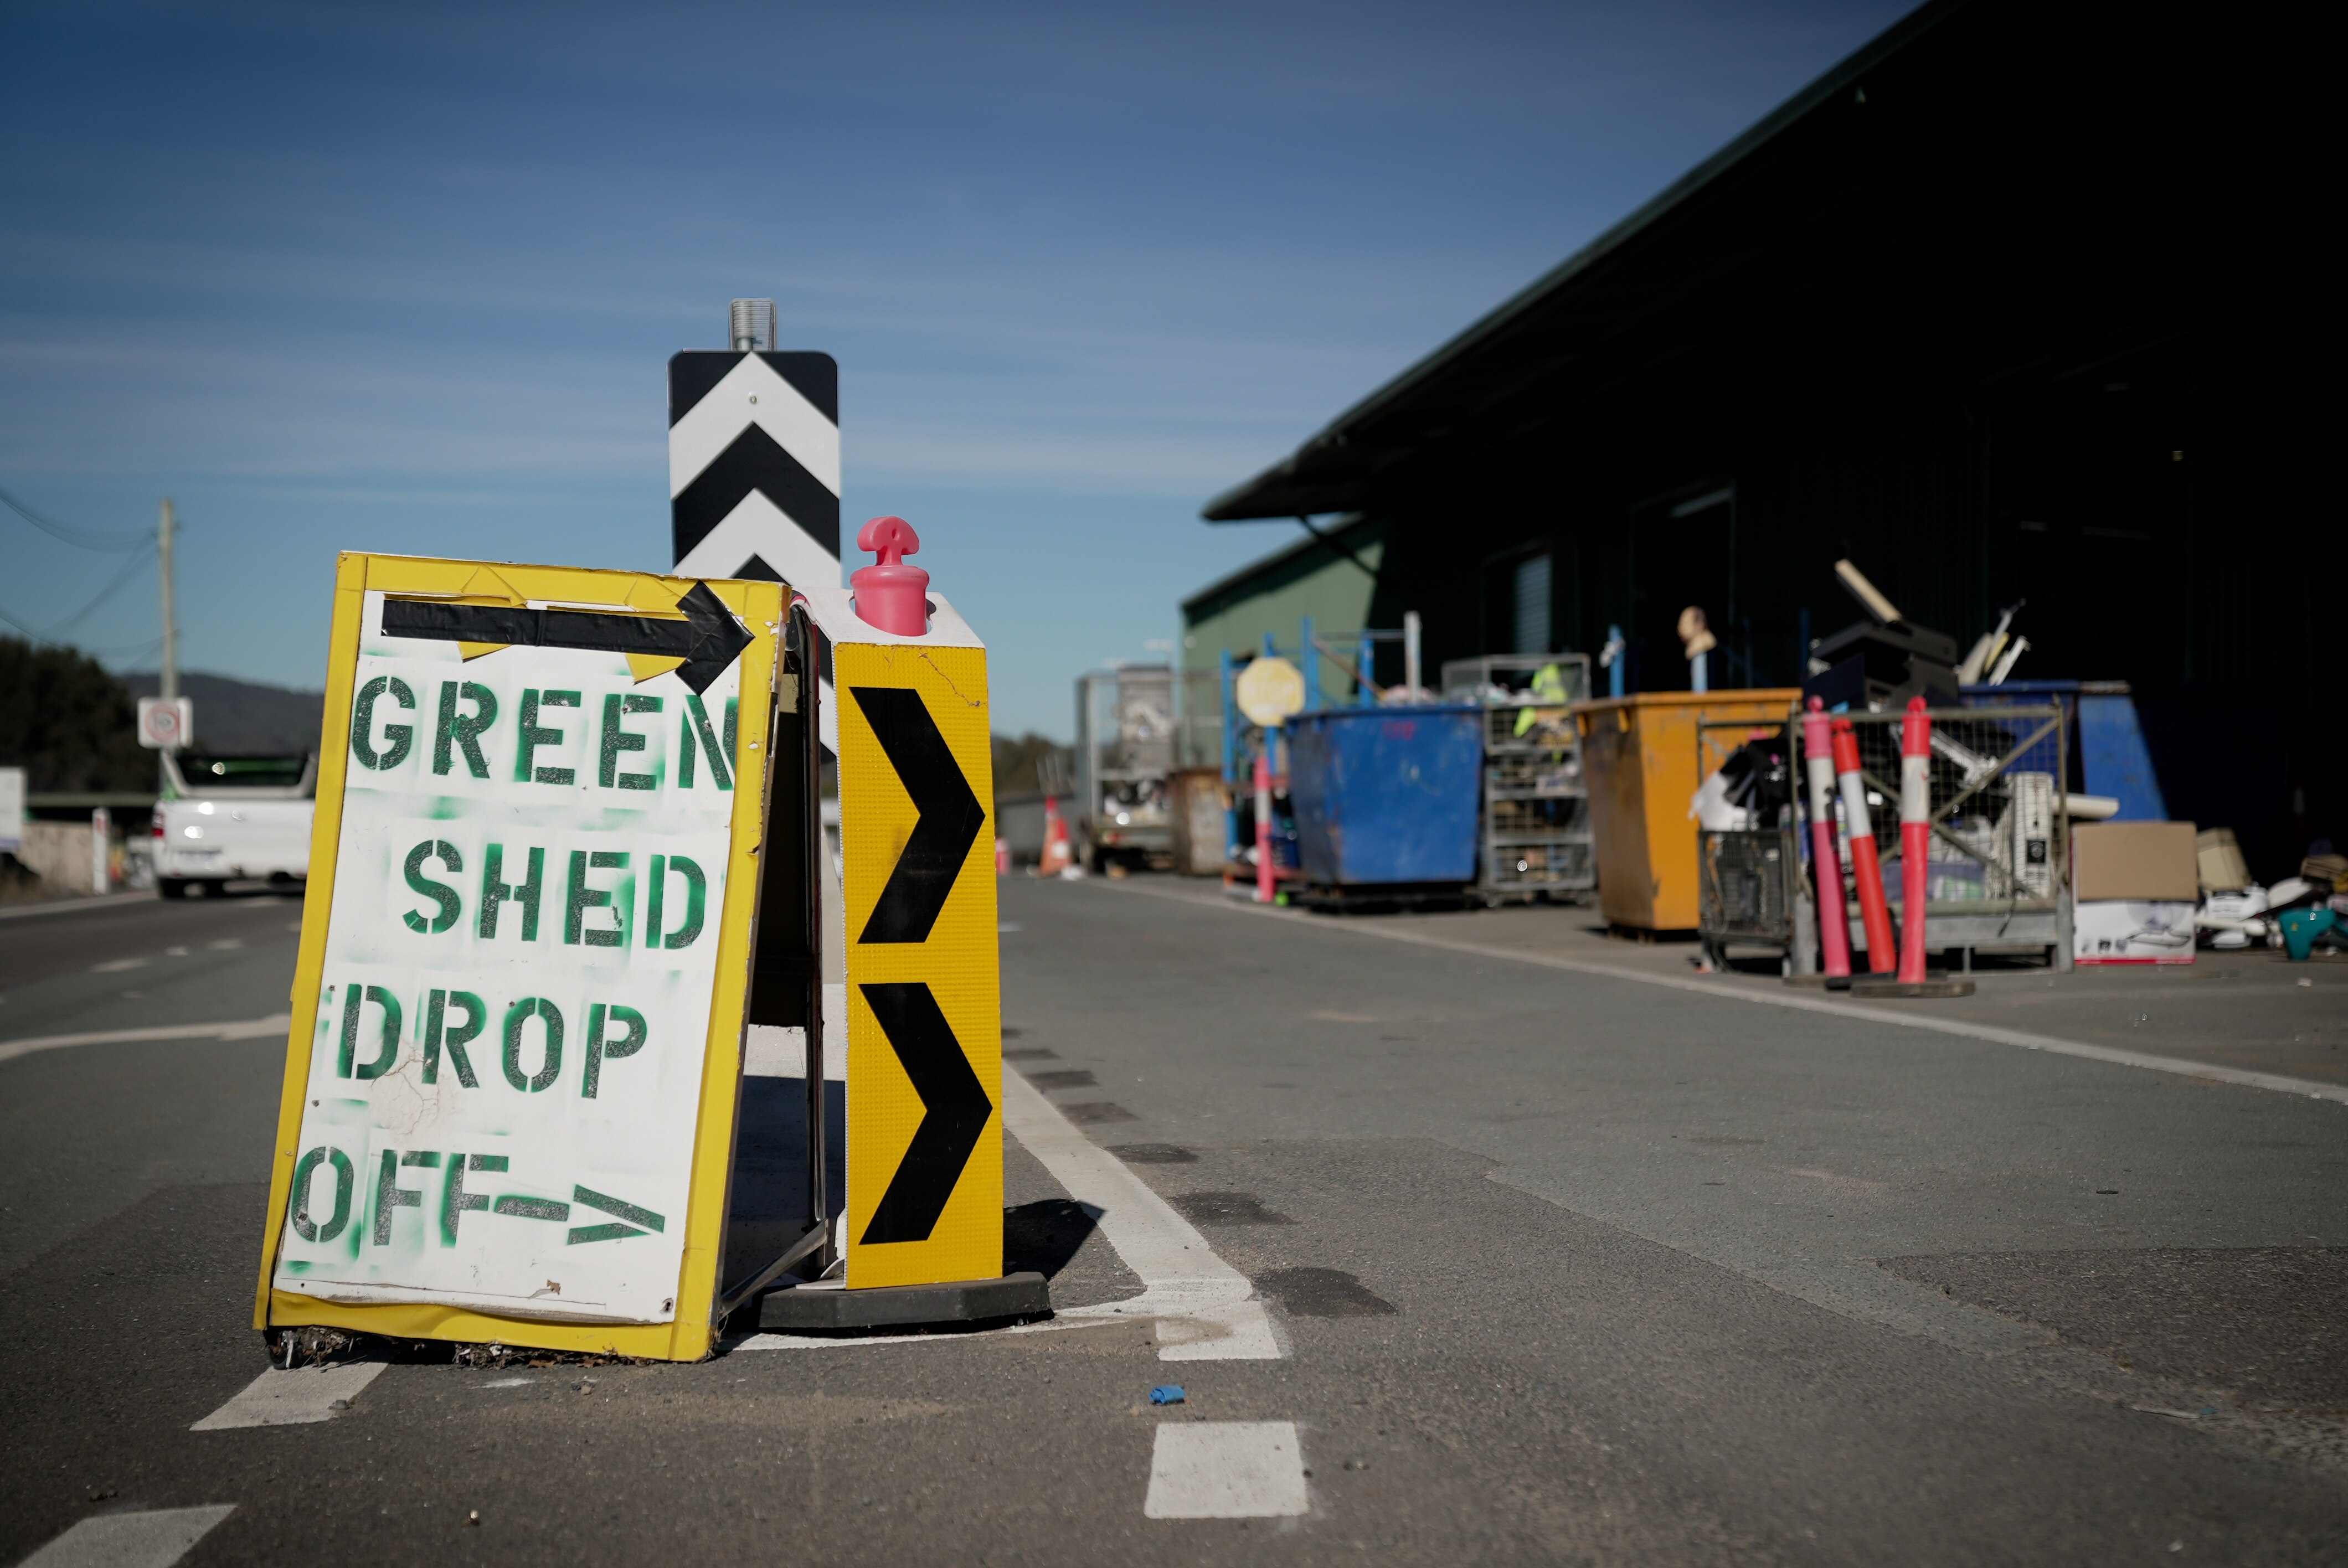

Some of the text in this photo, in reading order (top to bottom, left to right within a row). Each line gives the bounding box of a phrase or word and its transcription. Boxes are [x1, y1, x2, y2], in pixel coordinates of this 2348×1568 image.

[352, 676, 738, 791] GREEN
[403, 839, 706, 950] SHED
[337, 983, 647, 1099] DROP
[291, 1146, 509, 1248] OFF
